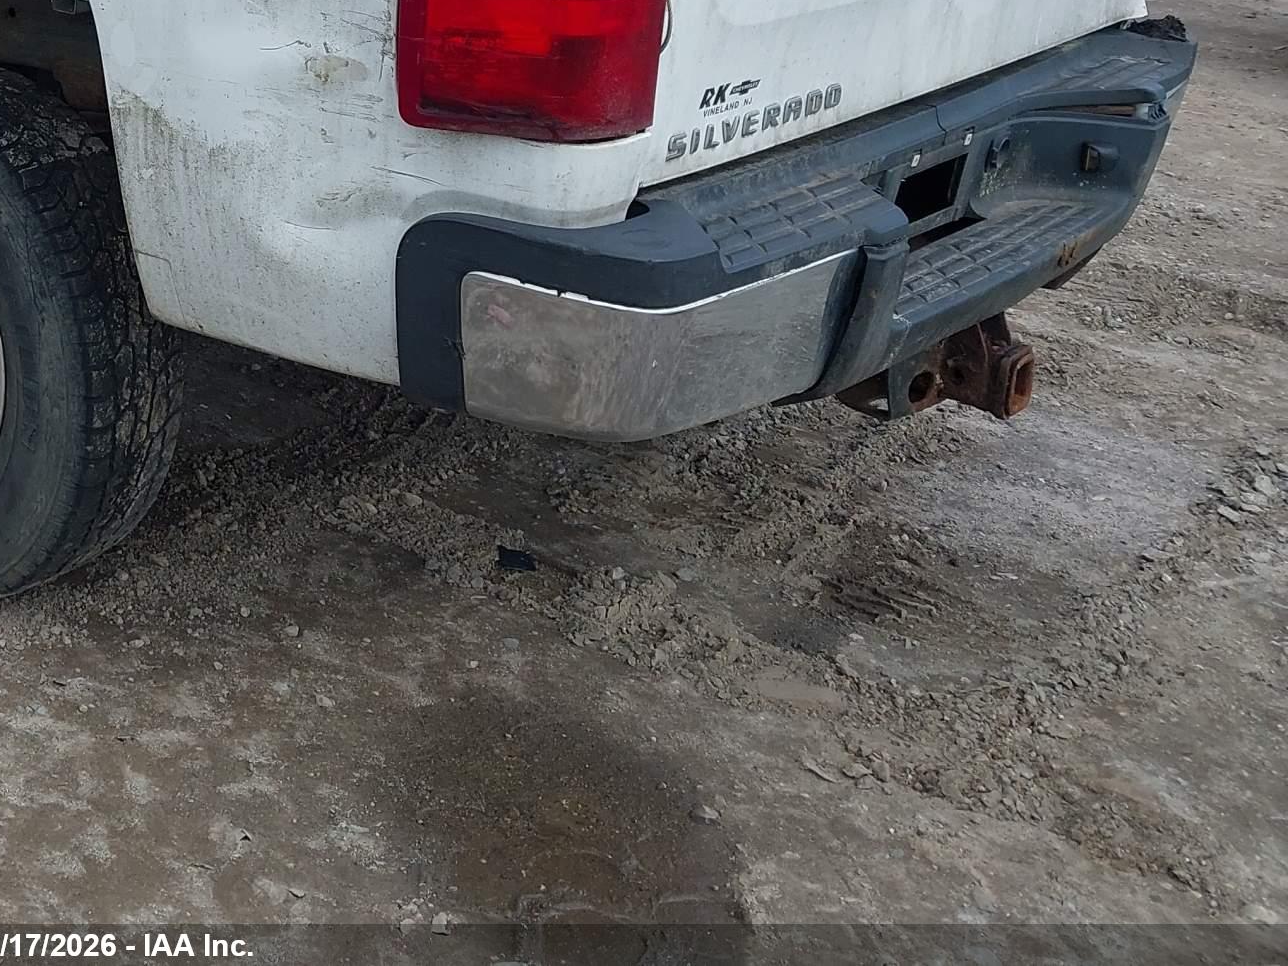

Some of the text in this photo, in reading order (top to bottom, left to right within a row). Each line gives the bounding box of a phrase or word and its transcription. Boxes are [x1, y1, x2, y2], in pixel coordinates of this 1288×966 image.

[699, 83, 732, 109] RK
[703, 97, 753, 117] VINELAND NJ
[665, 84, 842, 162] SILVERADO
